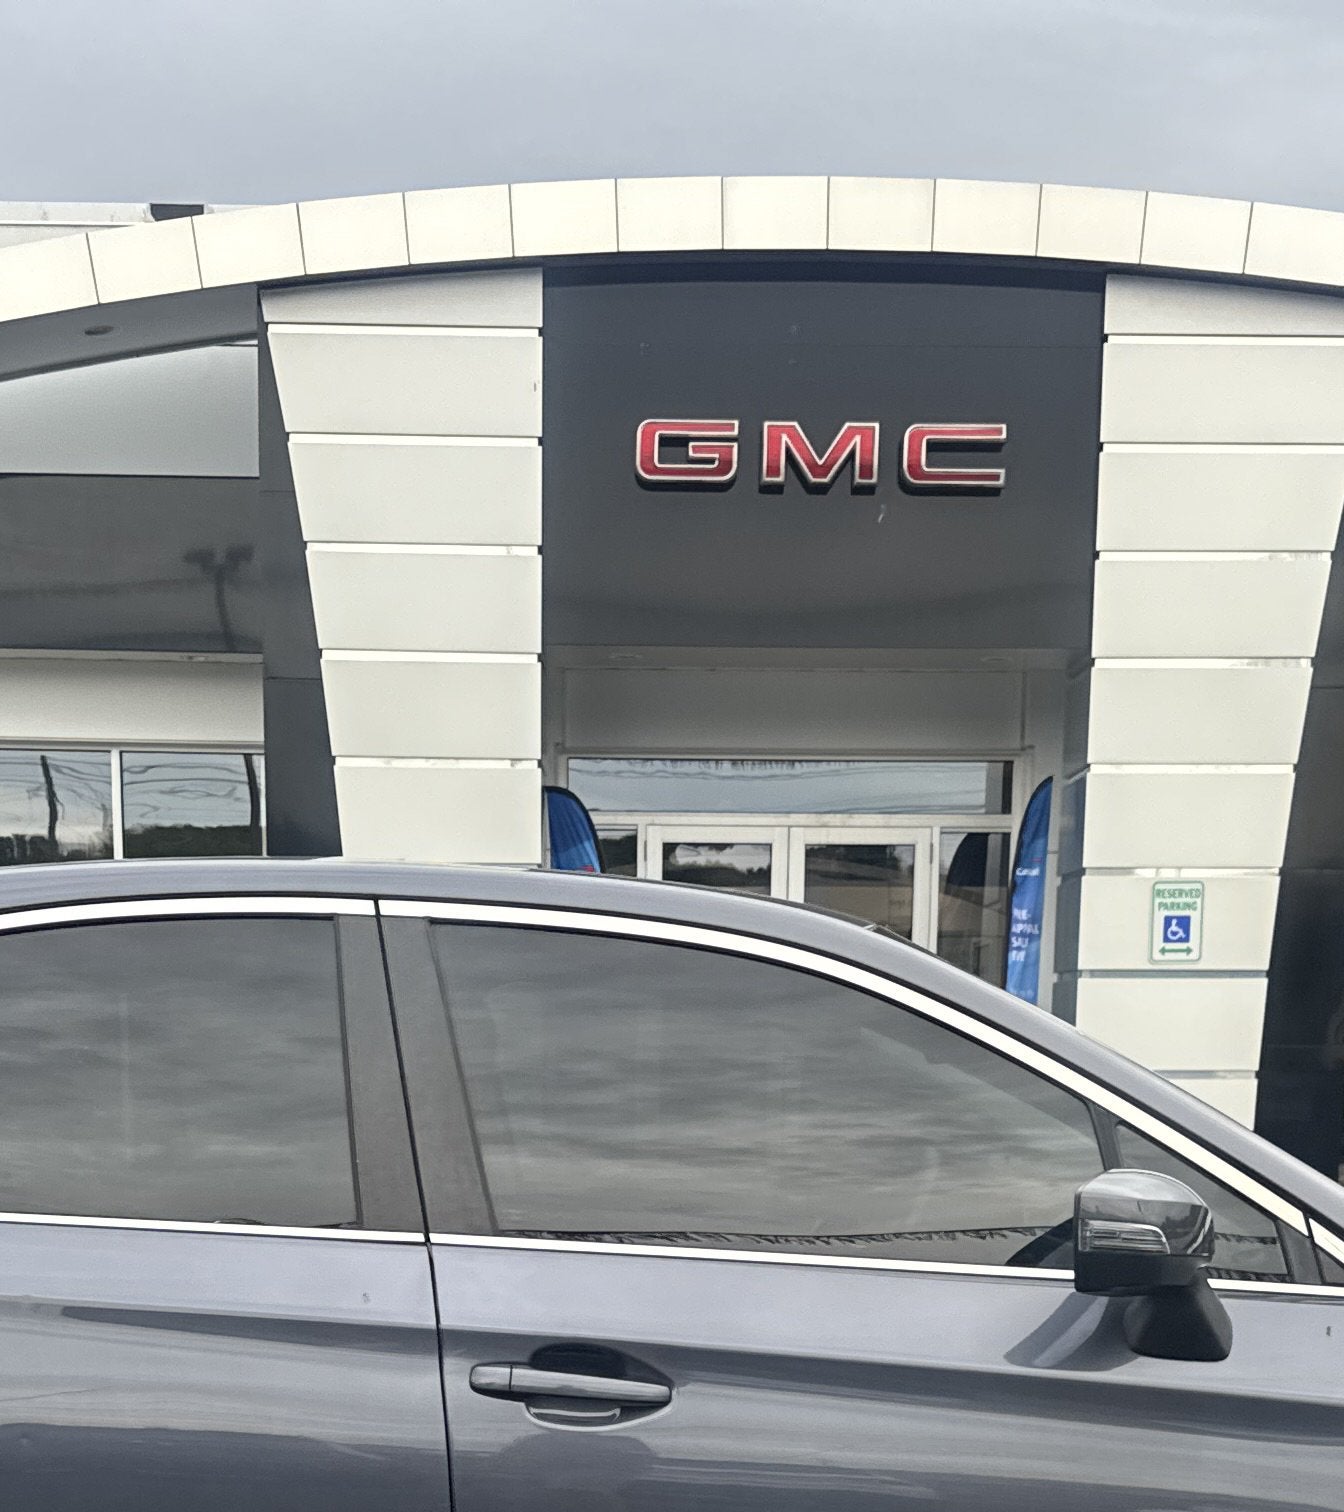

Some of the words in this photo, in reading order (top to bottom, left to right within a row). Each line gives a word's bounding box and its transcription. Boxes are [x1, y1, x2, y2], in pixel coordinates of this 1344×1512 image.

[635, 418, 1007, 488] GMC
[1155, 888, 1201, 899] RESERVED
[1157, 901, 1197, 911] PARKING
